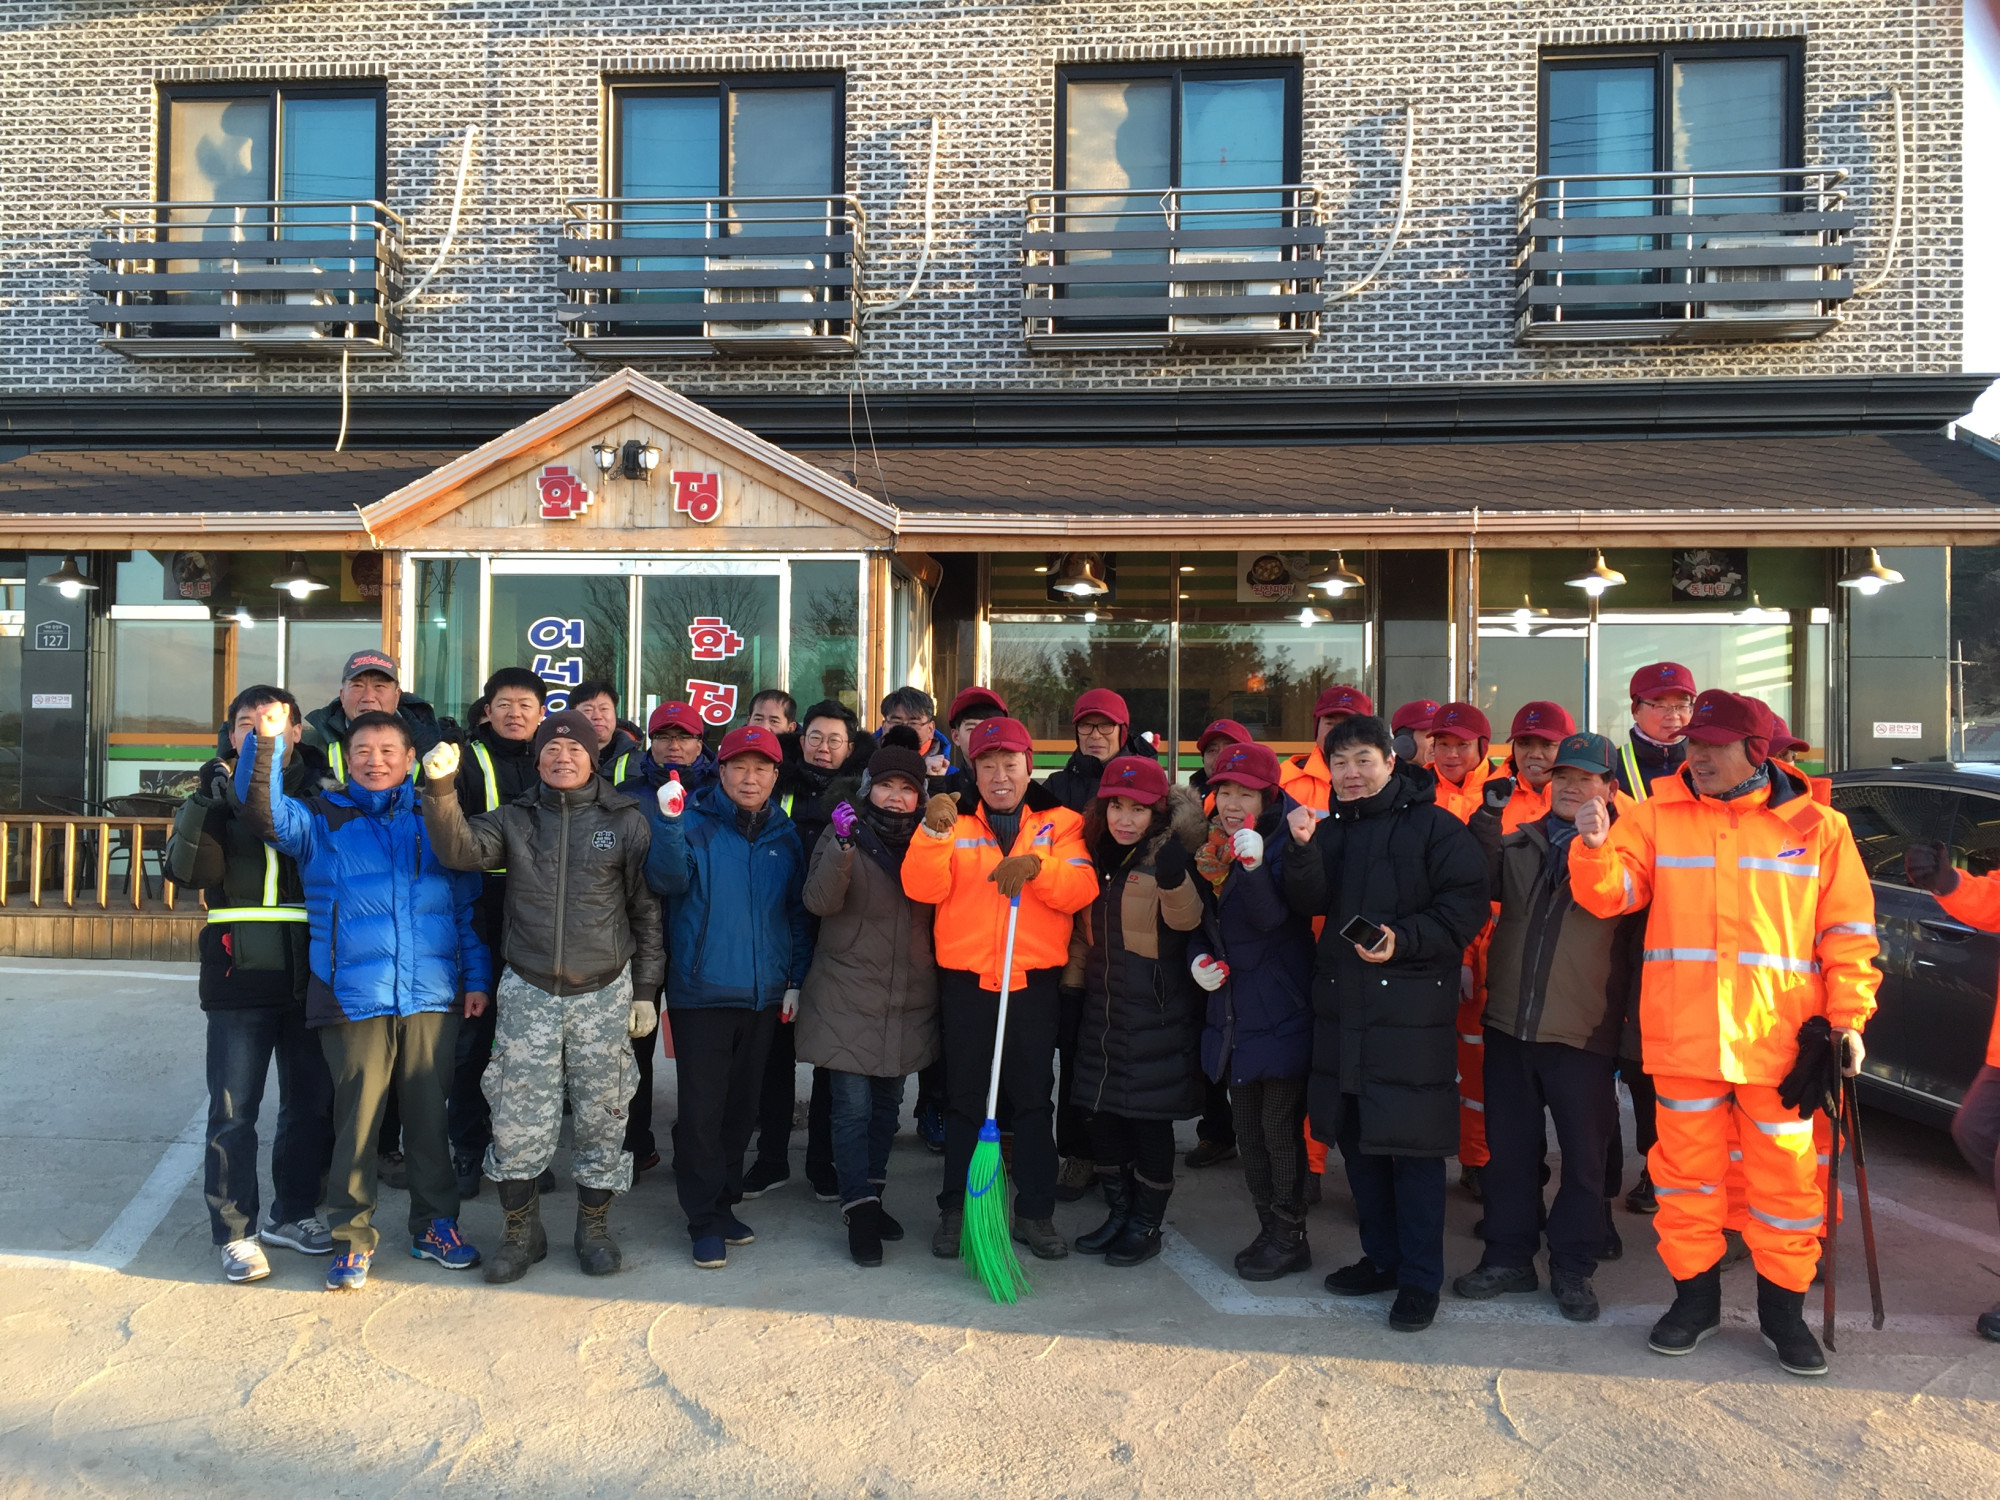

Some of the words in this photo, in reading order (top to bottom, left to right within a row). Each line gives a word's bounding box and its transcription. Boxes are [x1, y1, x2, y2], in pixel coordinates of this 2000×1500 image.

[180, 582, 211, 597] 냉면
[358, 583, 383, 597] 육개
[43, 635, 63, 647] 127
